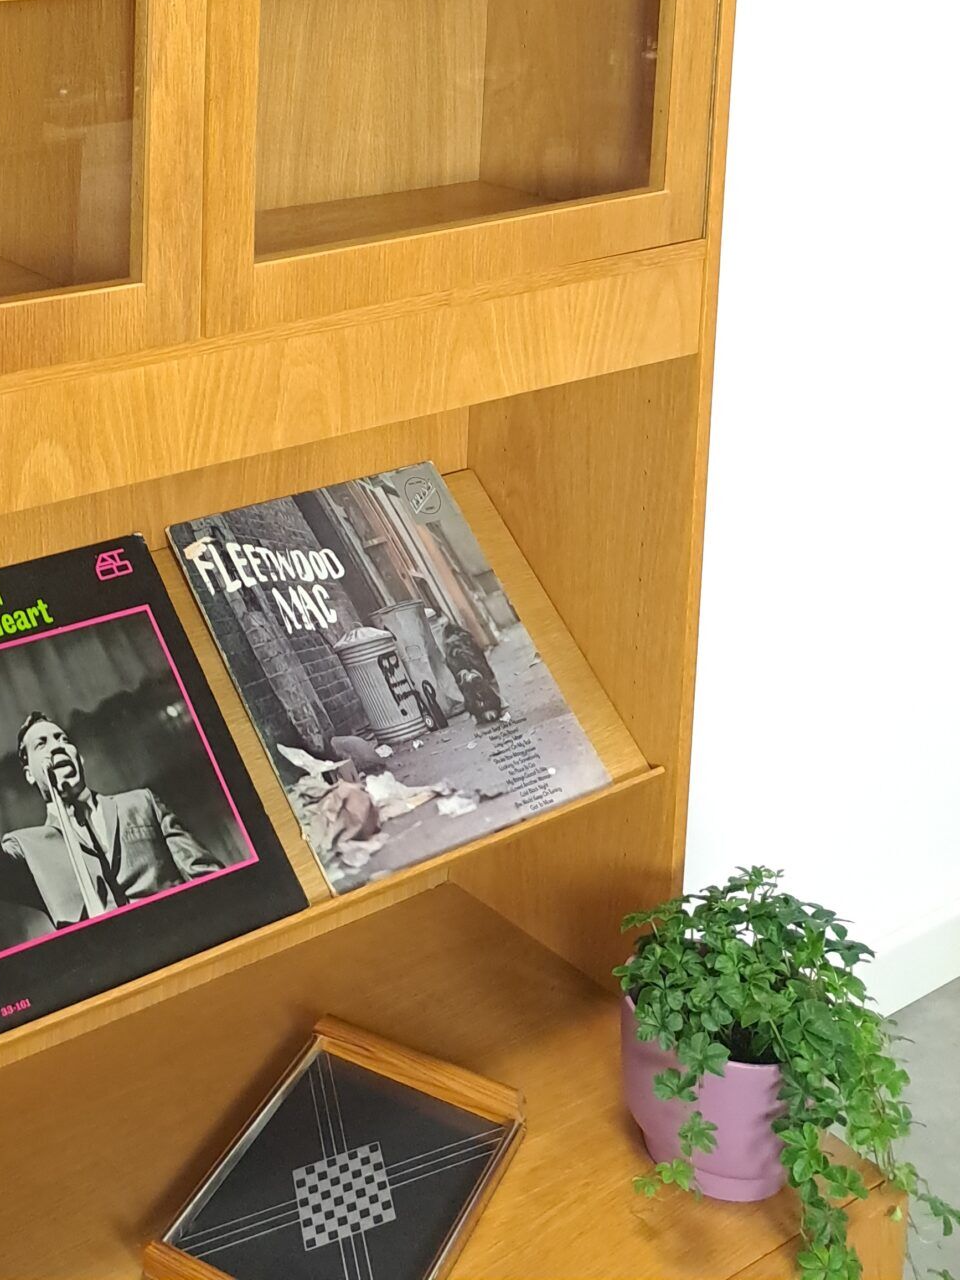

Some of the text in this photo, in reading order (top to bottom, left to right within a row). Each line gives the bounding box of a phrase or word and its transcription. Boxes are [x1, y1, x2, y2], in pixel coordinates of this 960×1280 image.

[190, 541, 345, 596] FLEETWOOD
[272, 584, 338, 634] MAC
[0, 998, 31, 1017] 33-101
